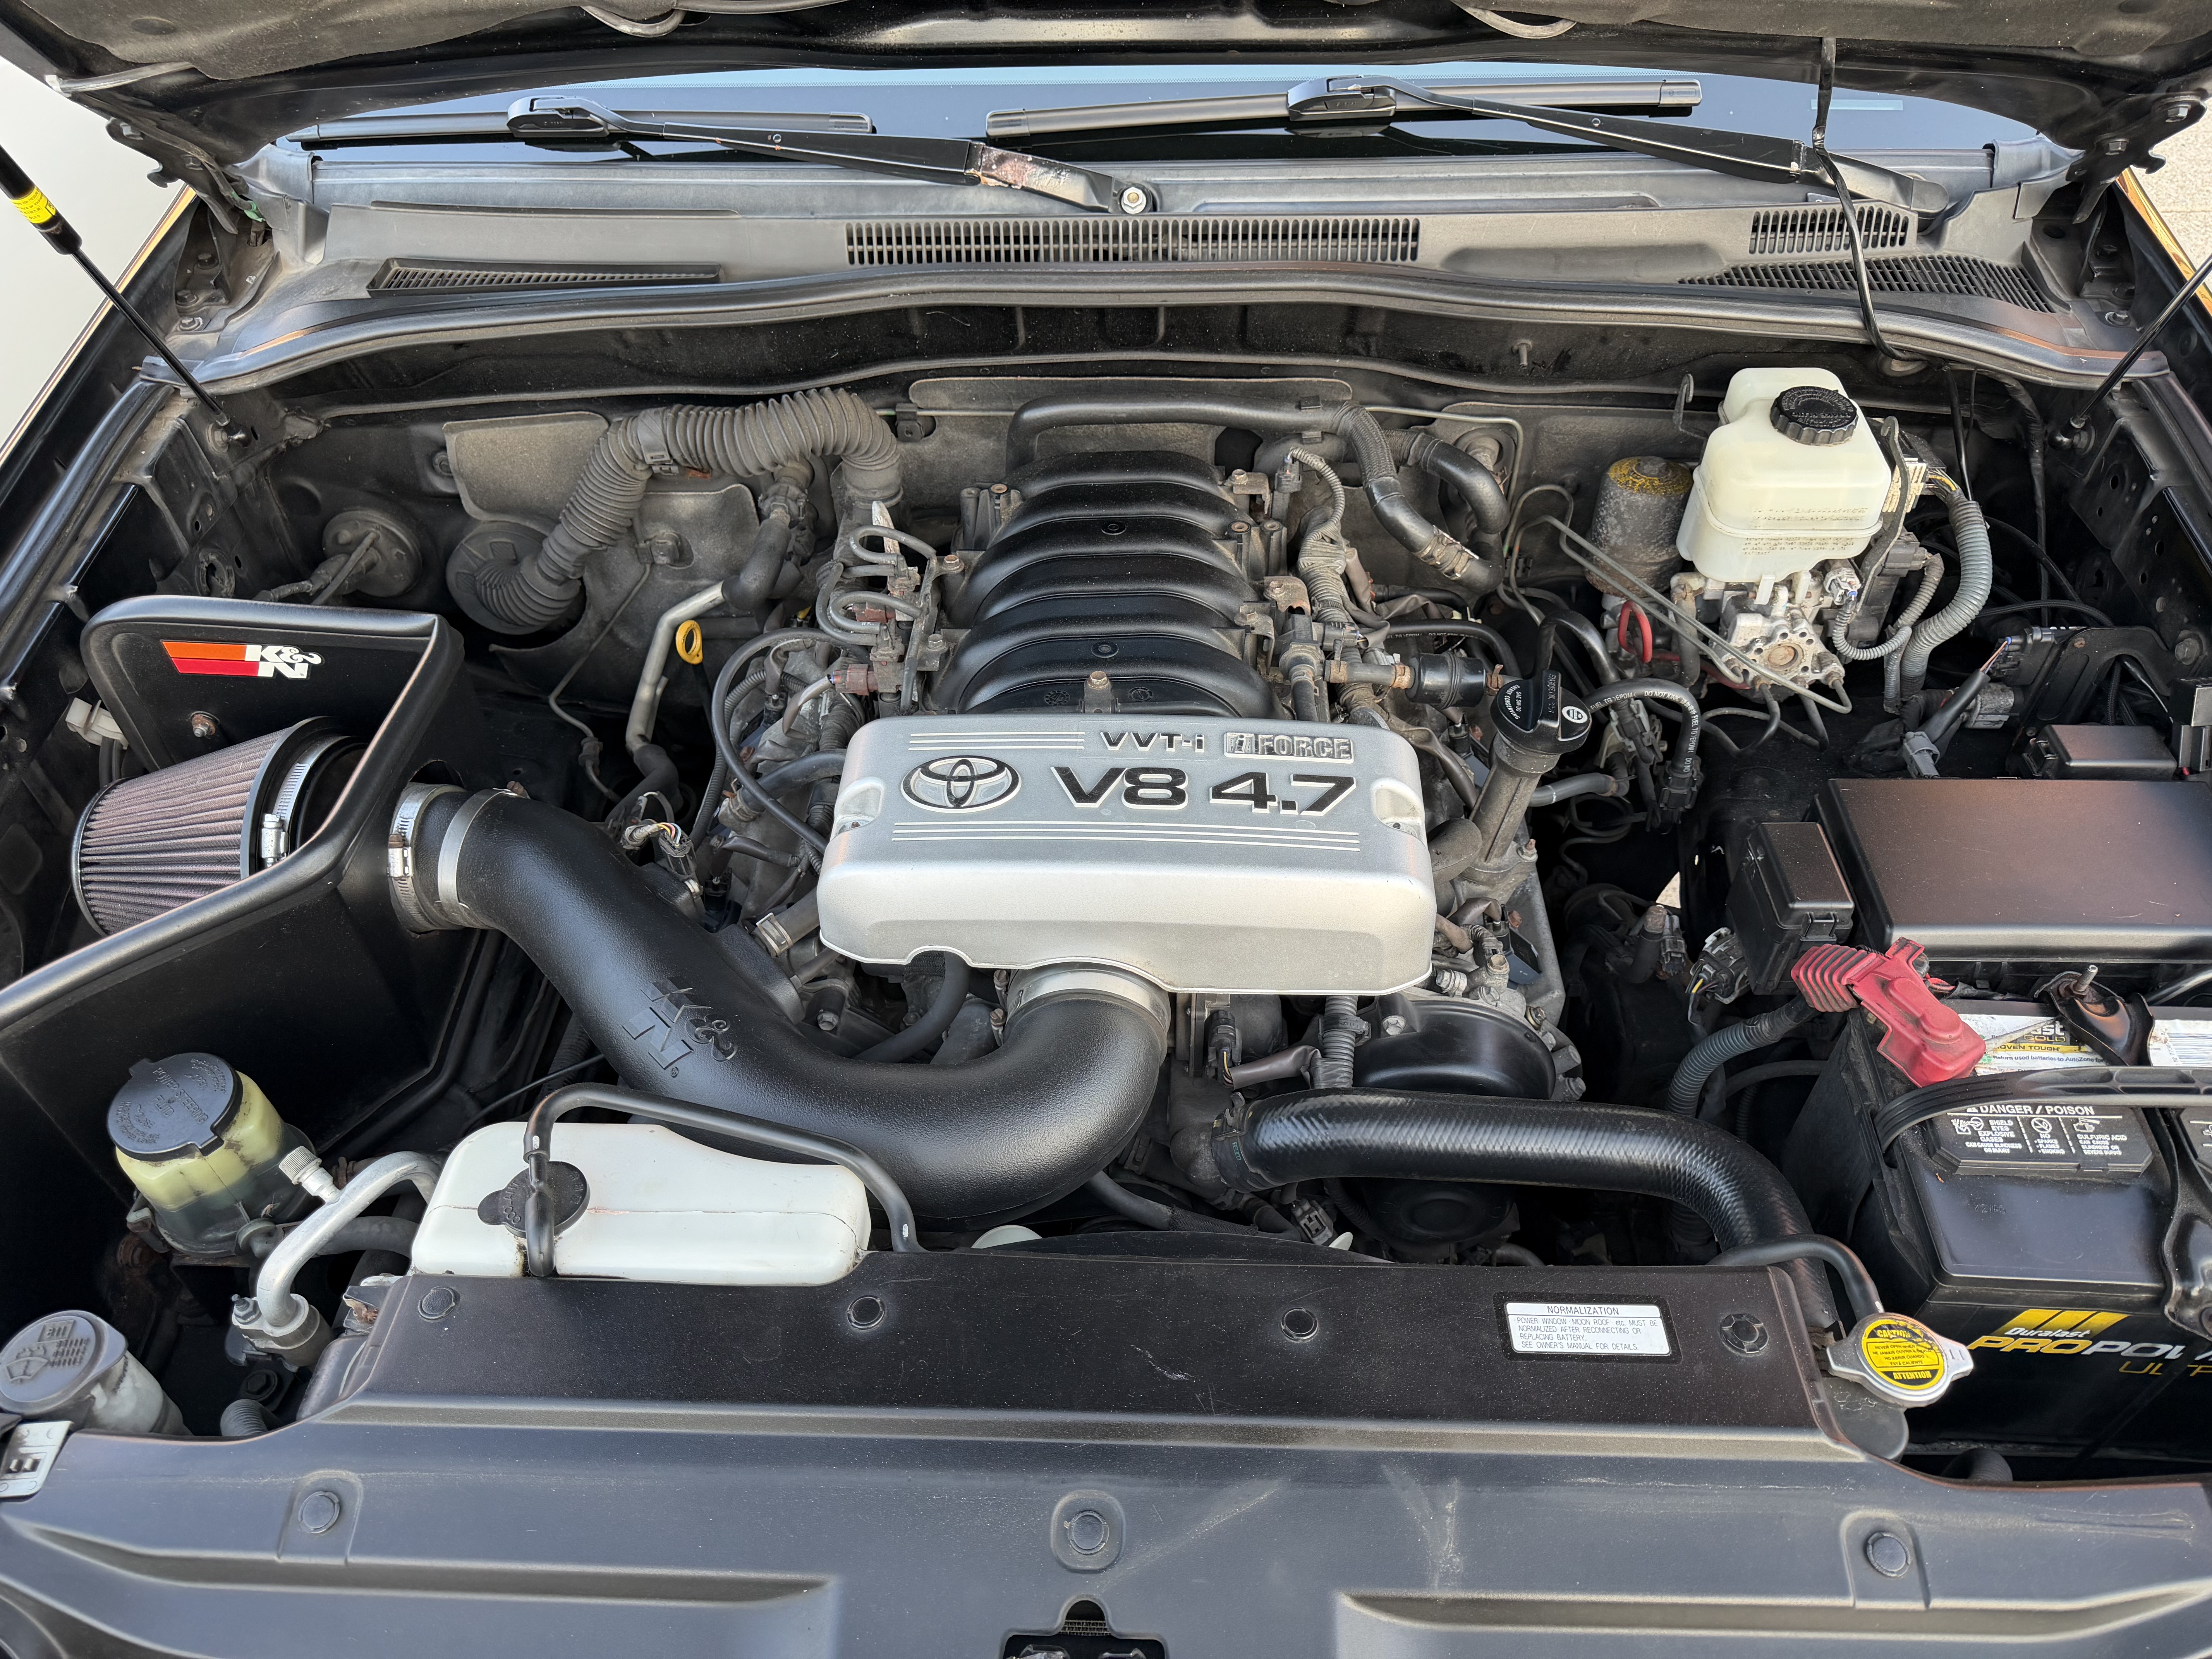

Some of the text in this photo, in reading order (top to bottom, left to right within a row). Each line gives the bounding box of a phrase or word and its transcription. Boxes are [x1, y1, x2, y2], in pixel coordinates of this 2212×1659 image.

[245, 645, 322, 679] K&N
[1504, 684, 1520, 720] ENERGY CONSERVING
[1590, 702, 1604, 710] FUEL
[1691, 714, 1699, 727] FUEL
[1100, 731, 1205, 753] VVT-i
[1683, 764, 1691, 773] NO
[1051, 766, 1357, 816] V8 4.7
[153, 1067, 180, 1090] POWER
[175, 1089, 209, 1124] STEERING
[154, 1094, 174, 1117] FLUID
[1979, 1105, 2033, 1114] DANGER
[2045, 1106, 2095, 1115] POISON
[1547, 1305, 1620, 1315] NORMALIZATION
[1877, 1329, 1911, 1338] CAUTION
[2004, 1327, 2091, 1338] Duralast
[1893, 1371, 1932, 1379] ATTENTION
